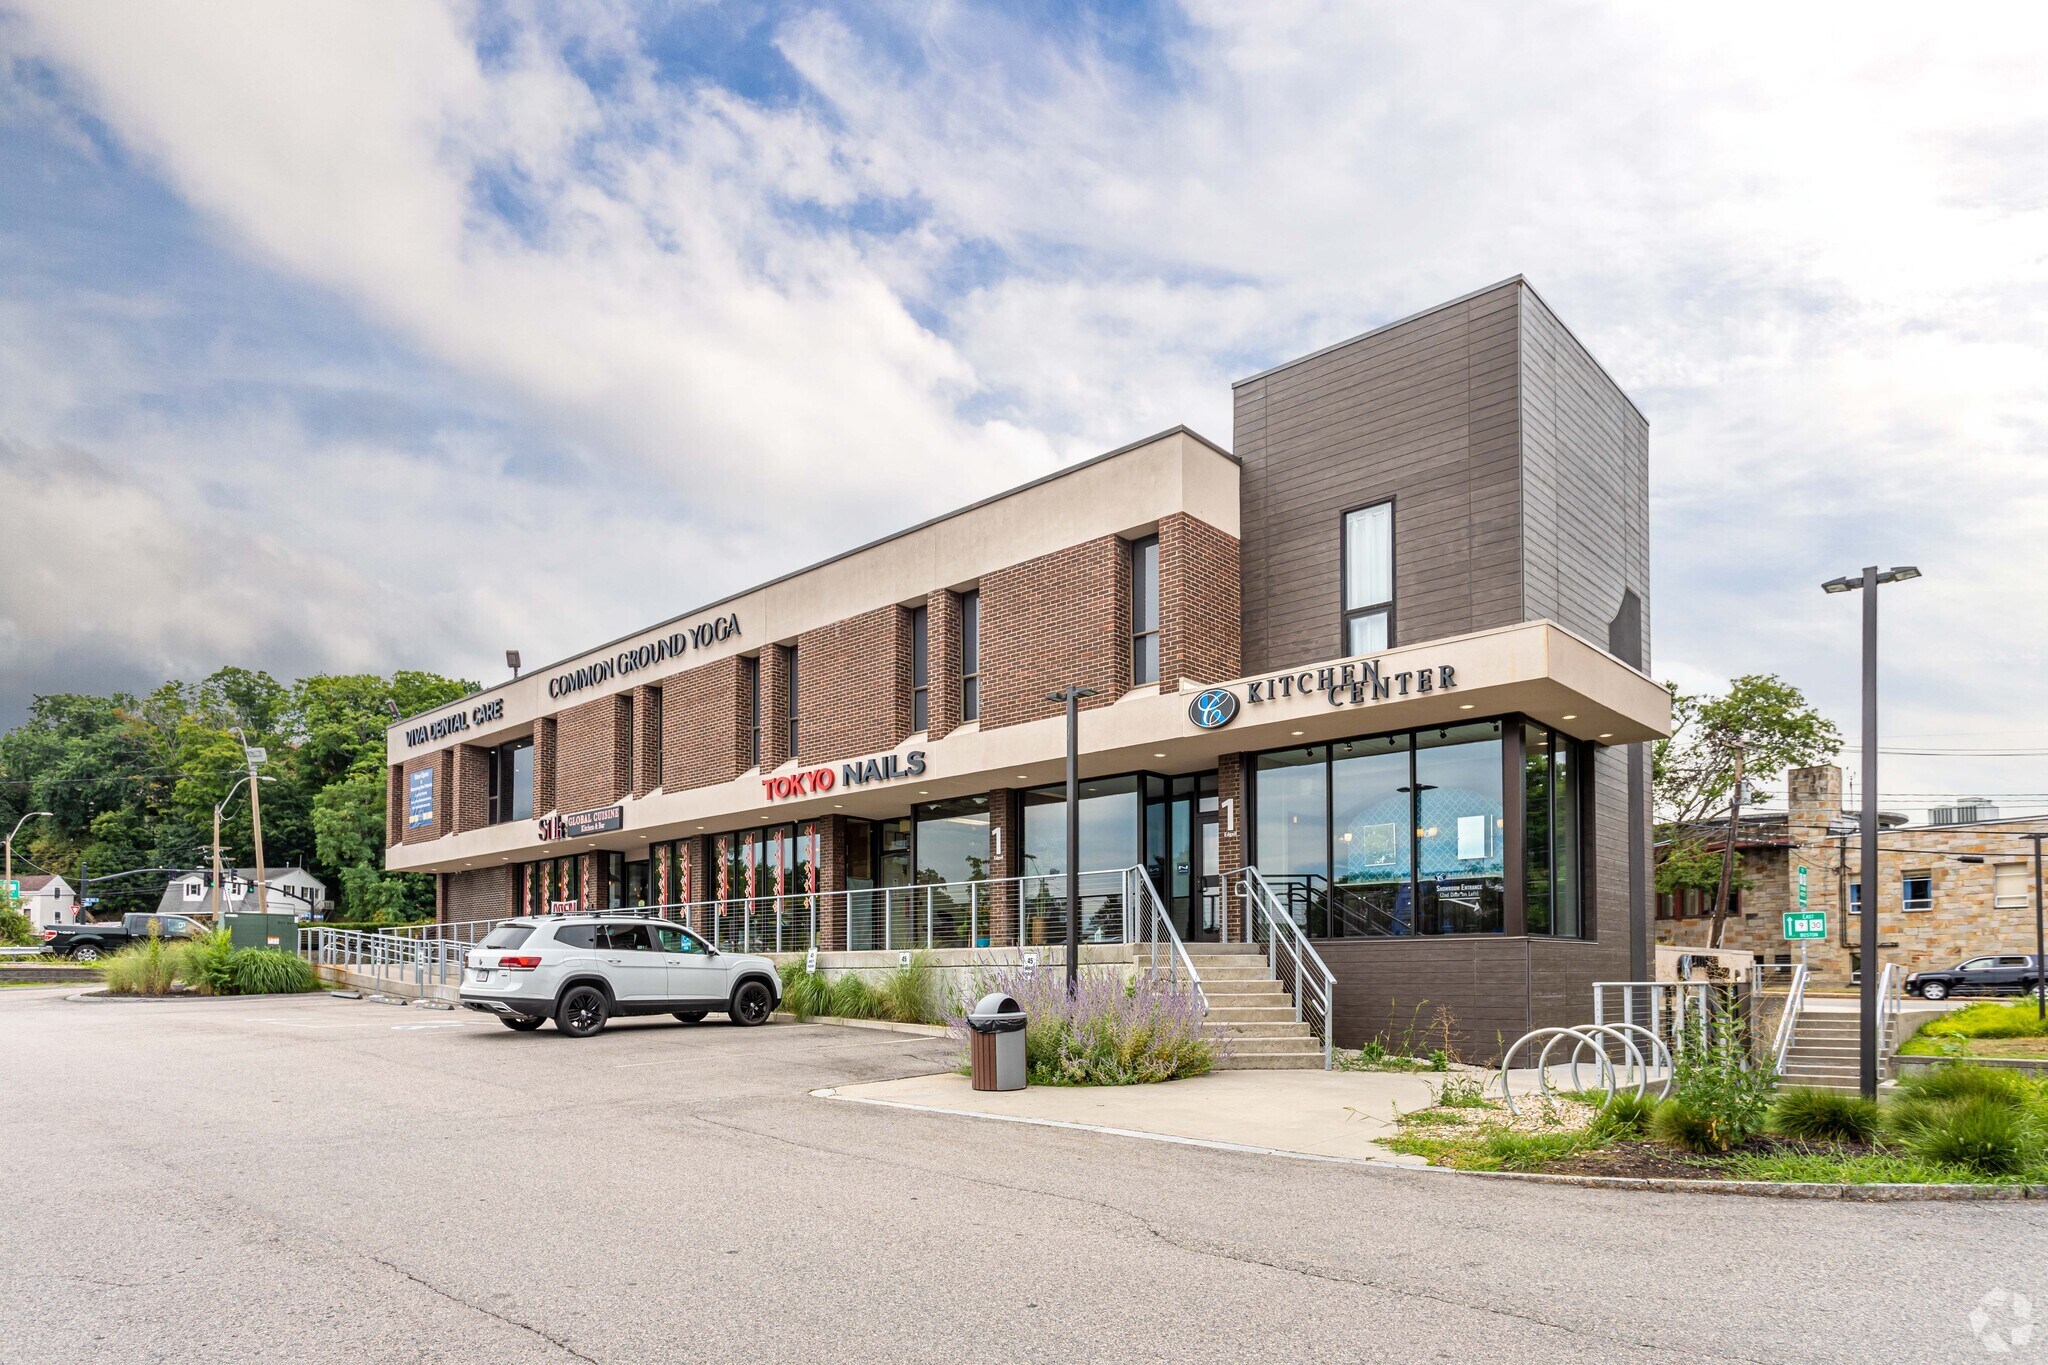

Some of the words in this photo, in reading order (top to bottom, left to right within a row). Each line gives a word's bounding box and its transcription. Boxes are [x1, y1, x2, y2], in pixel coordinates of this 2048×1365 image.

[549, 658, 613, 698] COMMON
[616, 633, 686, 674] GROUND
[688, 613, 741, 650] YOGA
[1247, 659, 1381, 704] KITCHEN
[1327, 664, 1457, 706] CENTER
[406, 725, 429, 747] VIVA
[430, 711, 470, 739] DENTAL
[472, 698, 504, 725] CARE
[762, 768, 835, 801] TOKYO
[842, 750, 927, 787] NAILS
[568, 813, 592, 827] GLOBAL
[593, 808, 619, 821] CUISINE
[1221, 798, 1234, 831] 1
[991, 826, 1002, 855] 1
